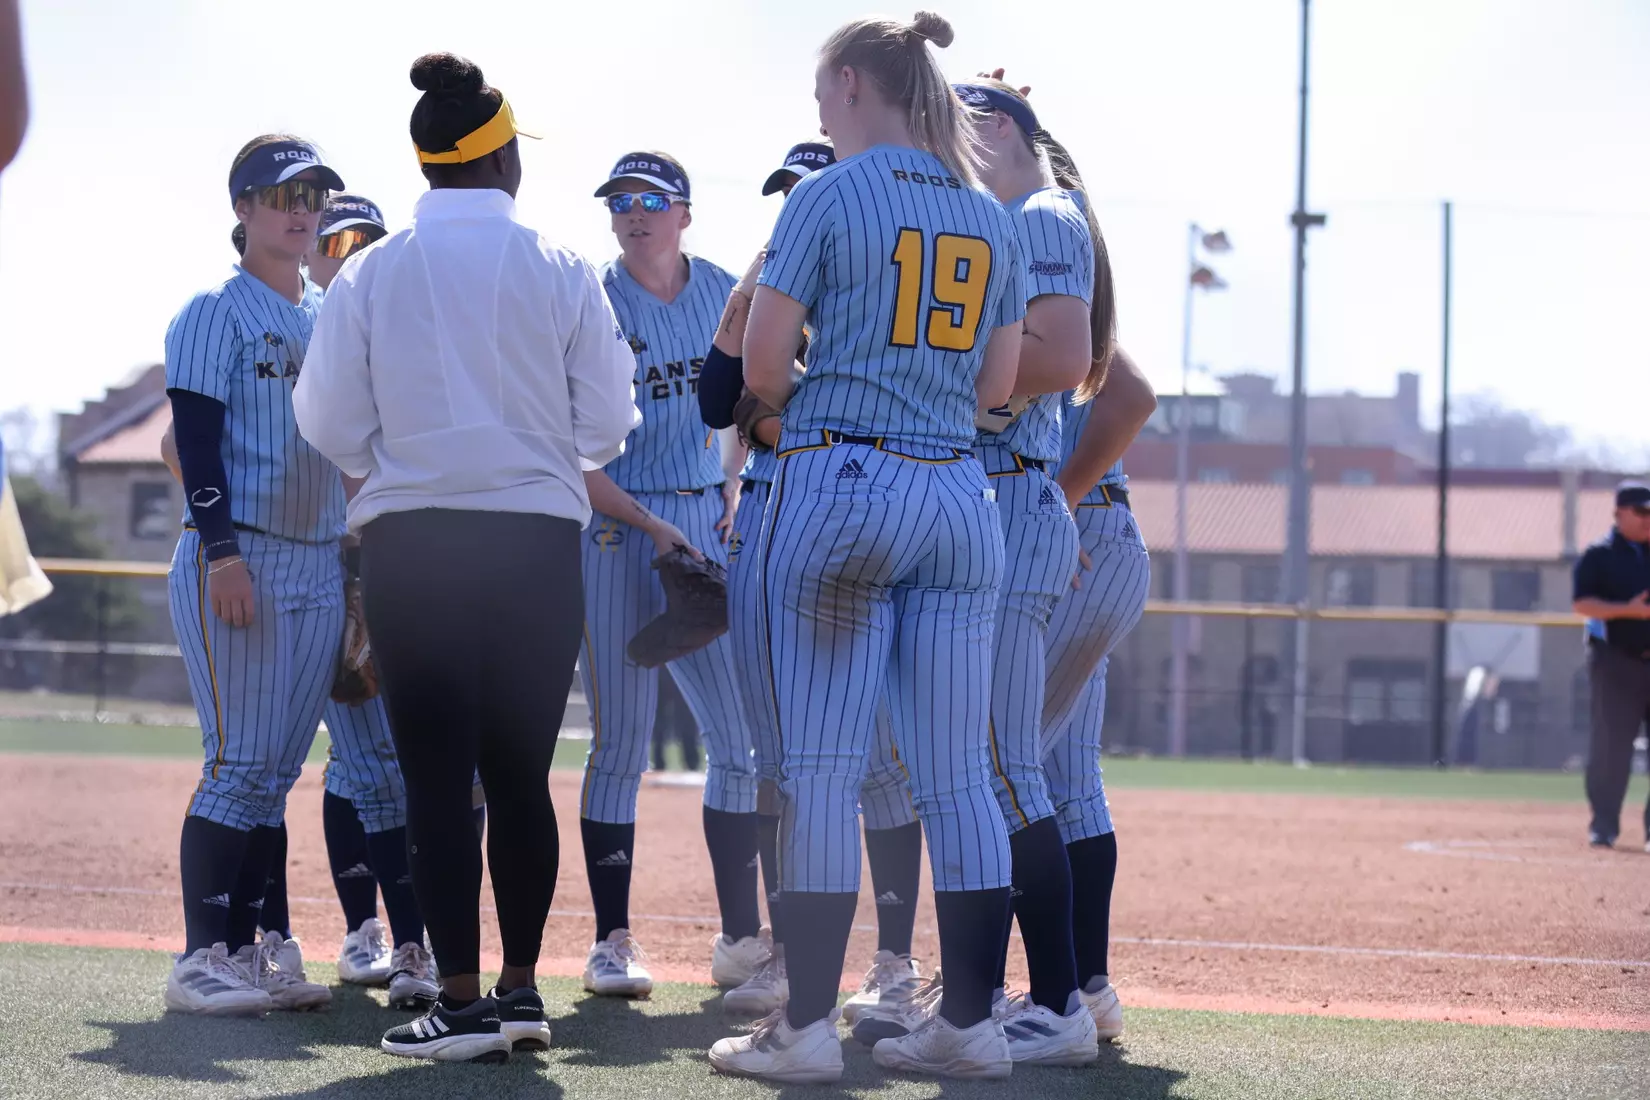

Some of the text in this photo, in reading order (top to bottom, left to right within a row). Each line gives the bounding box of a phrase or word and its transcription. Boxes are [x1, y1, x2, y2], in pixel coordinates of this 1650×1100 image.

[785, 151, 829, 167] ROOS
[616, 161, 661, 176] ROOS
[892, 169, 962, 190] ROOS
[1029, 261, 1073, 275] SUMMIT
[888, 226, 992, 353] 19
[835, 469, 868, 479] adidas
